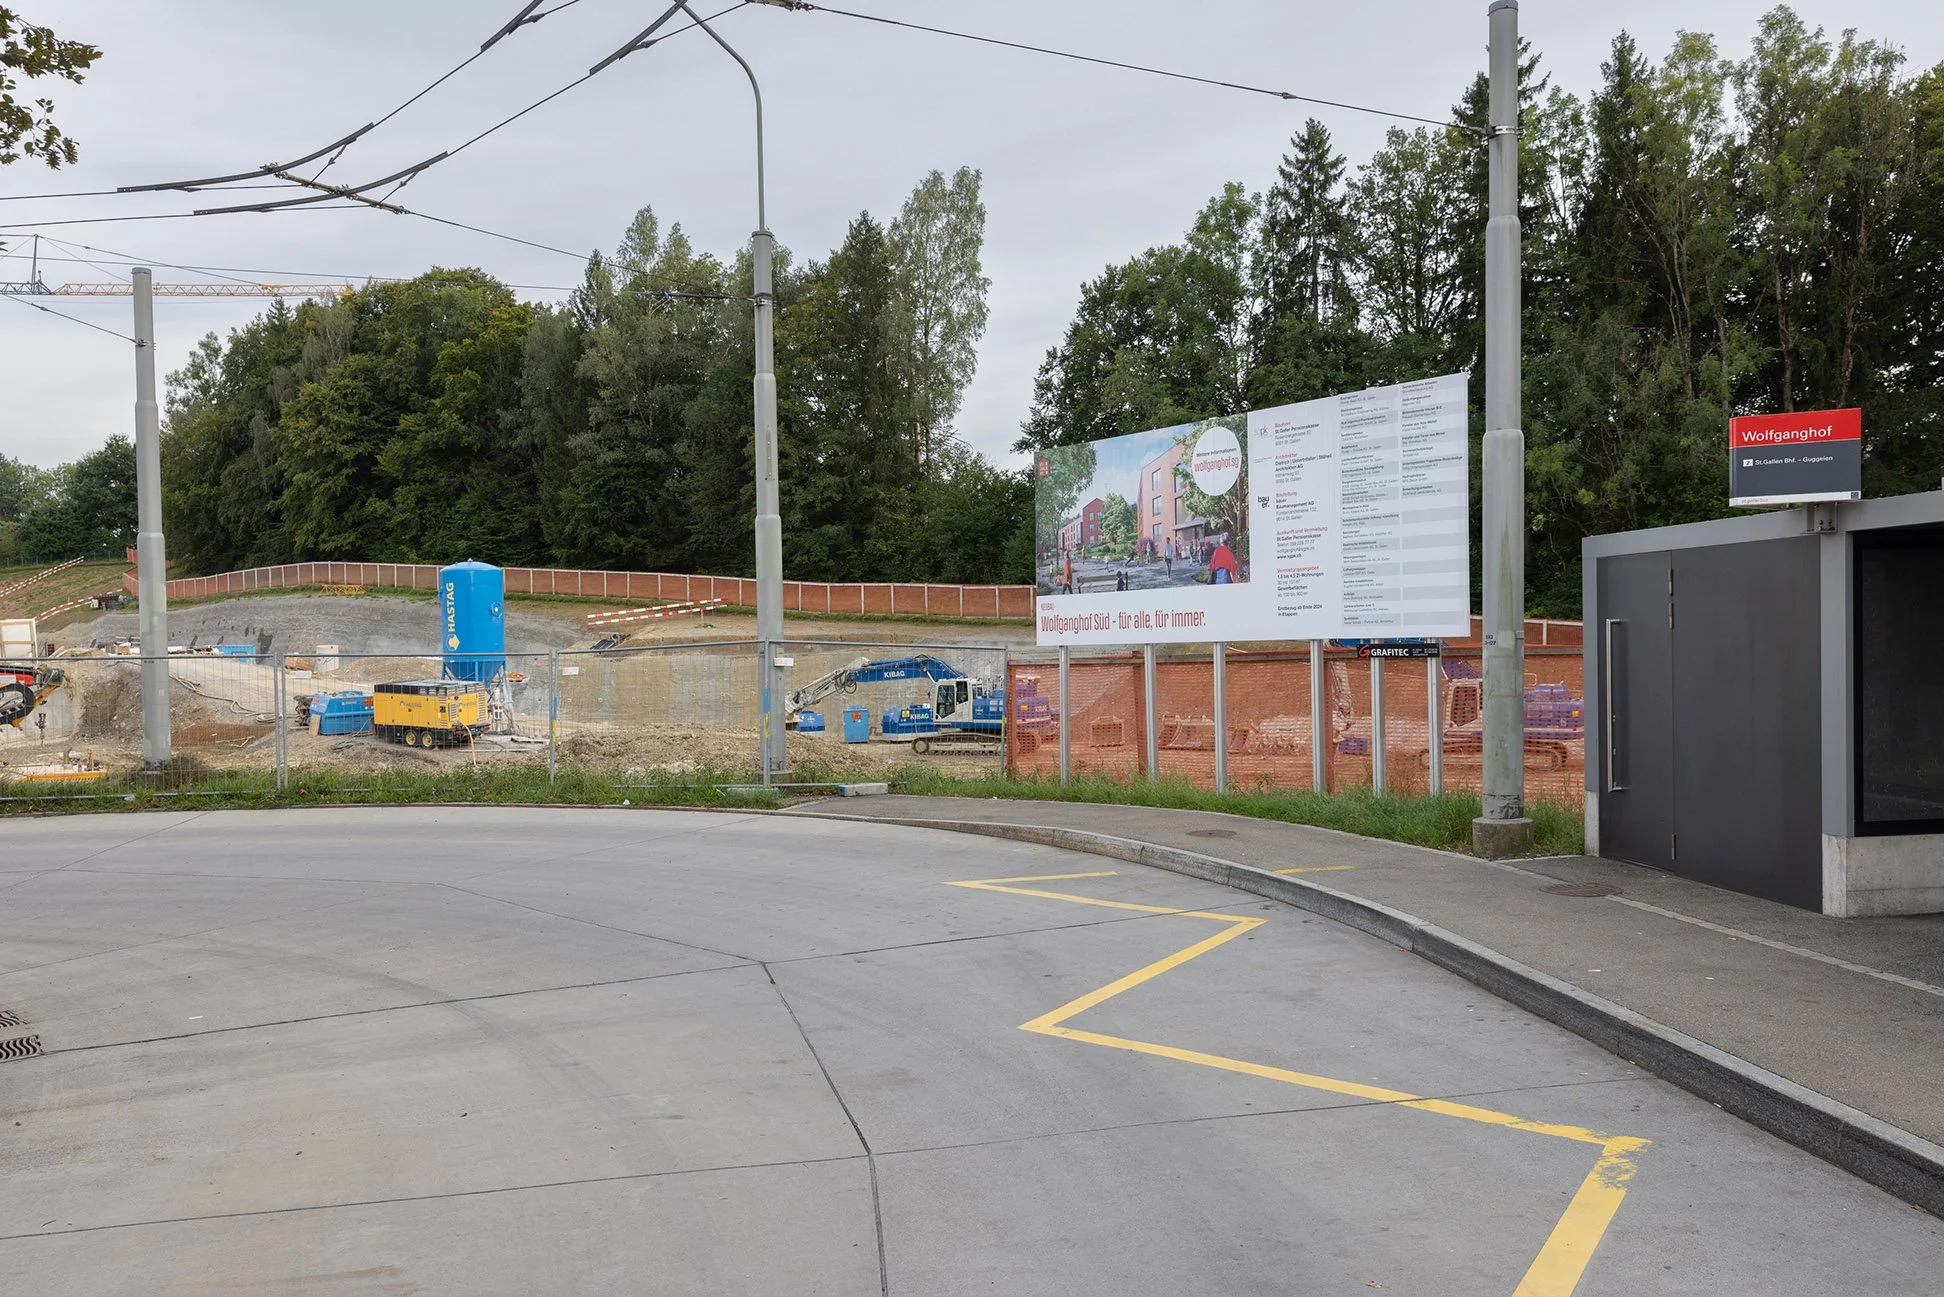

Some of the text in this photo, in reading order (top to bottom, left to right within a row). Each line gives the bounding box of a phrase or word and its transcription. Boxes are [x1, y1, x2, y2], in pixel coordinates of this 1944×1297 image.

[1742, 426, 1832, 442] Wolfganghof
[446, 582, 455, 632] HASTAG
[1041, 614, 1092, 634] Wolfganghof
[1094, 612, 1110, 630] Süd
[1118, 612, 1131, 629] für
[1134, 611, 1153, 630] alle,
[1155, 610, 1169, 628] für
[1171, 610, 1206, 627] immer.
